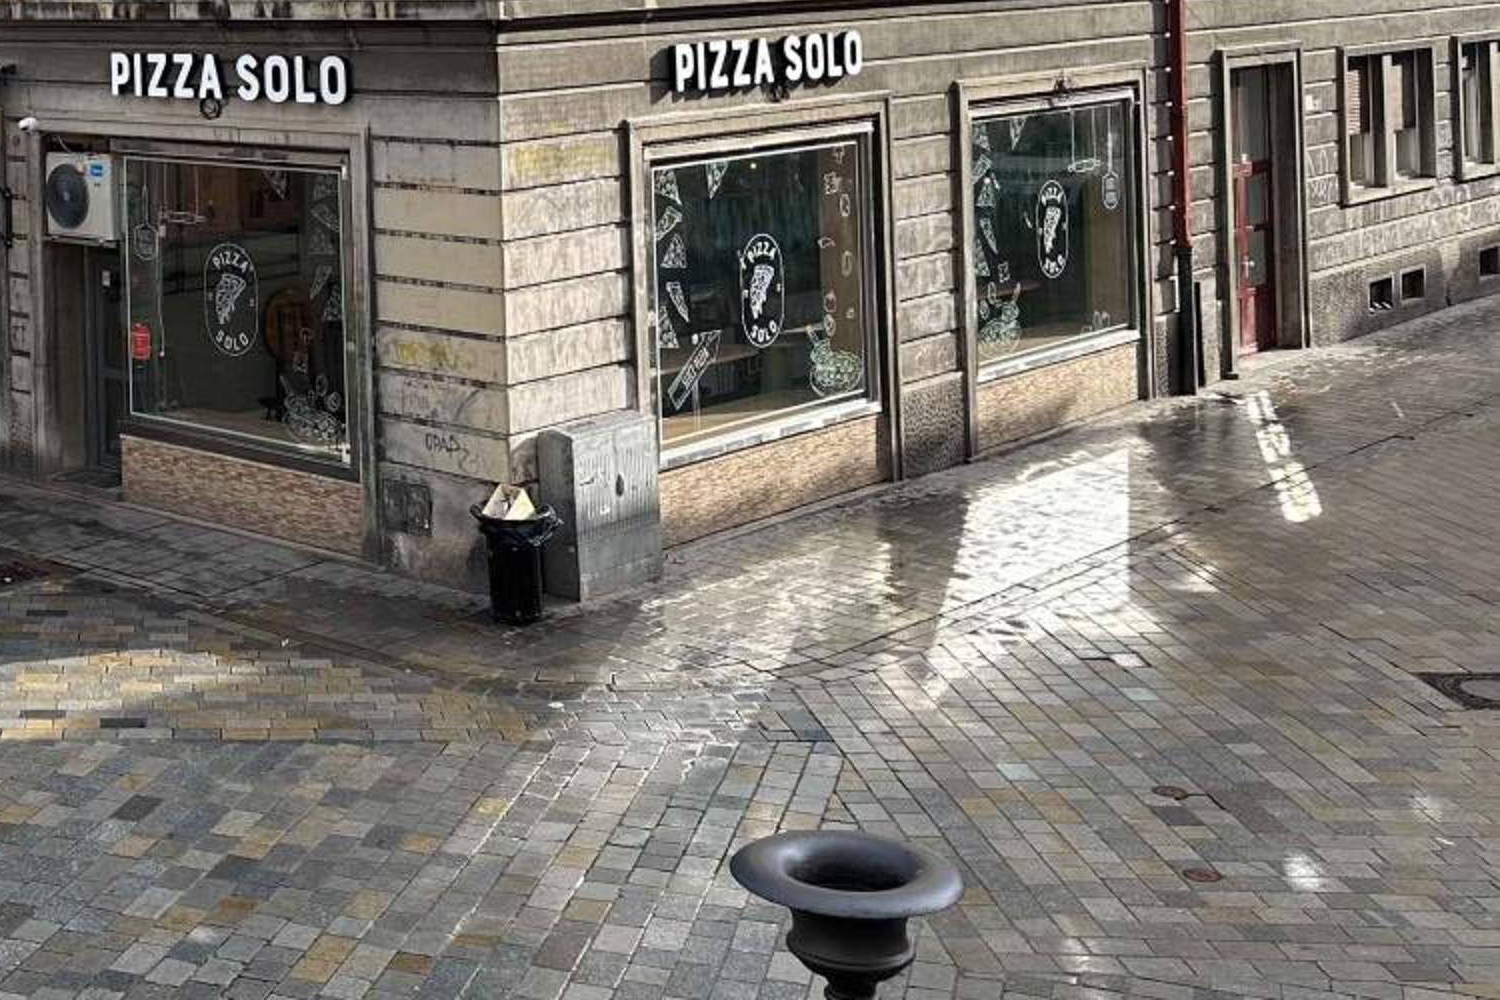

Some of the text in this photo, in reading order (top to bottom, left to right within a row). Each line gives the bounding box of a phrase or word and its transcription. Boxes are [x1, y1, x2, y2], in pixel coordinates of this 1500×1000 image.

[675, 30, 863, 92] PIZZA SOLO
[111, 52, 347, 105] PIZZA SOLO
[212, 251, 250, 273] PIZZA
[747, 241, 777, 263] PIZZA
[215, 329, 249, 351] SOLO
[750, 320, 778, 342] SOLO
